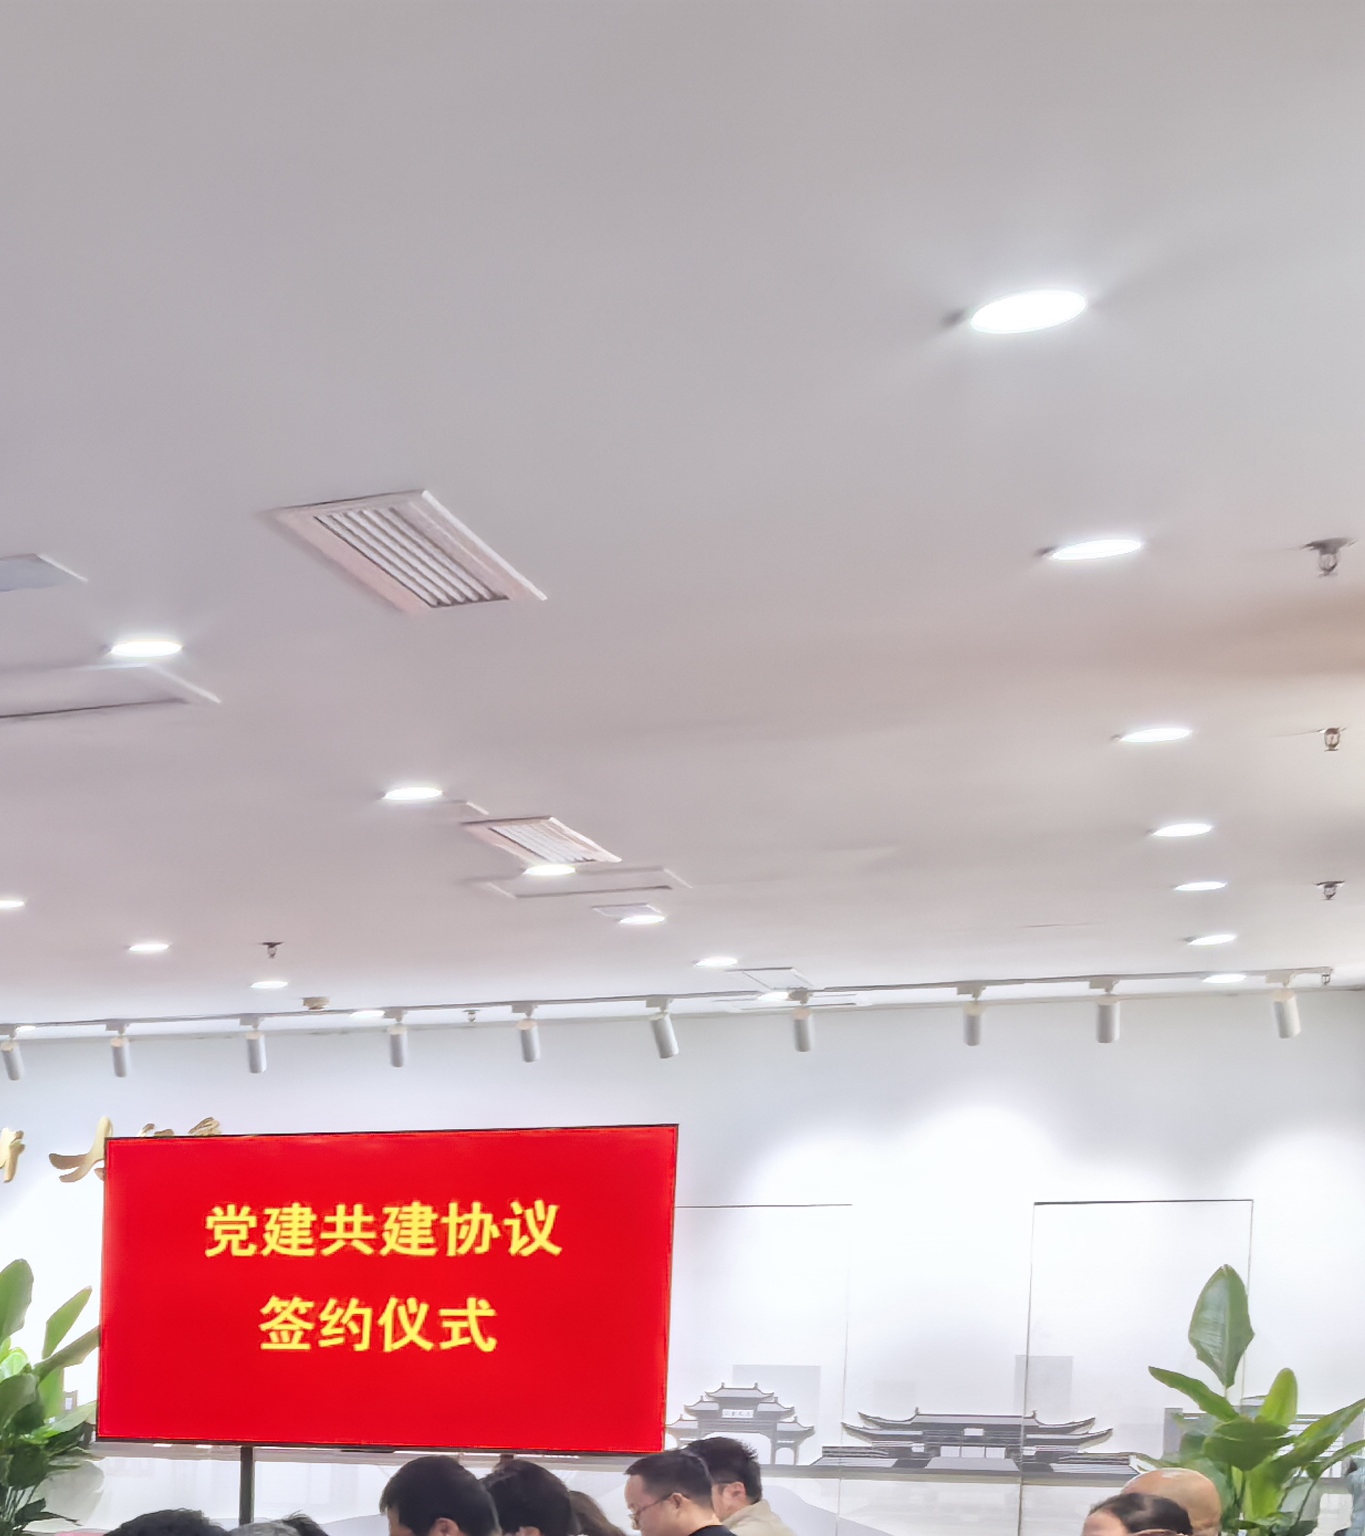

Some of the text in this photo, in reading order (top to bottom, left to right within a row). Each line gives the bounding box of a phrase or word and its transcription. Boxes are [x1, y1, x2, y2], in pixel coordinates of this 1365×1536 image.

[203, 1199, 563, 1258] 党建共建协议
[258, 1295, 497, 1353] 签约仪式
